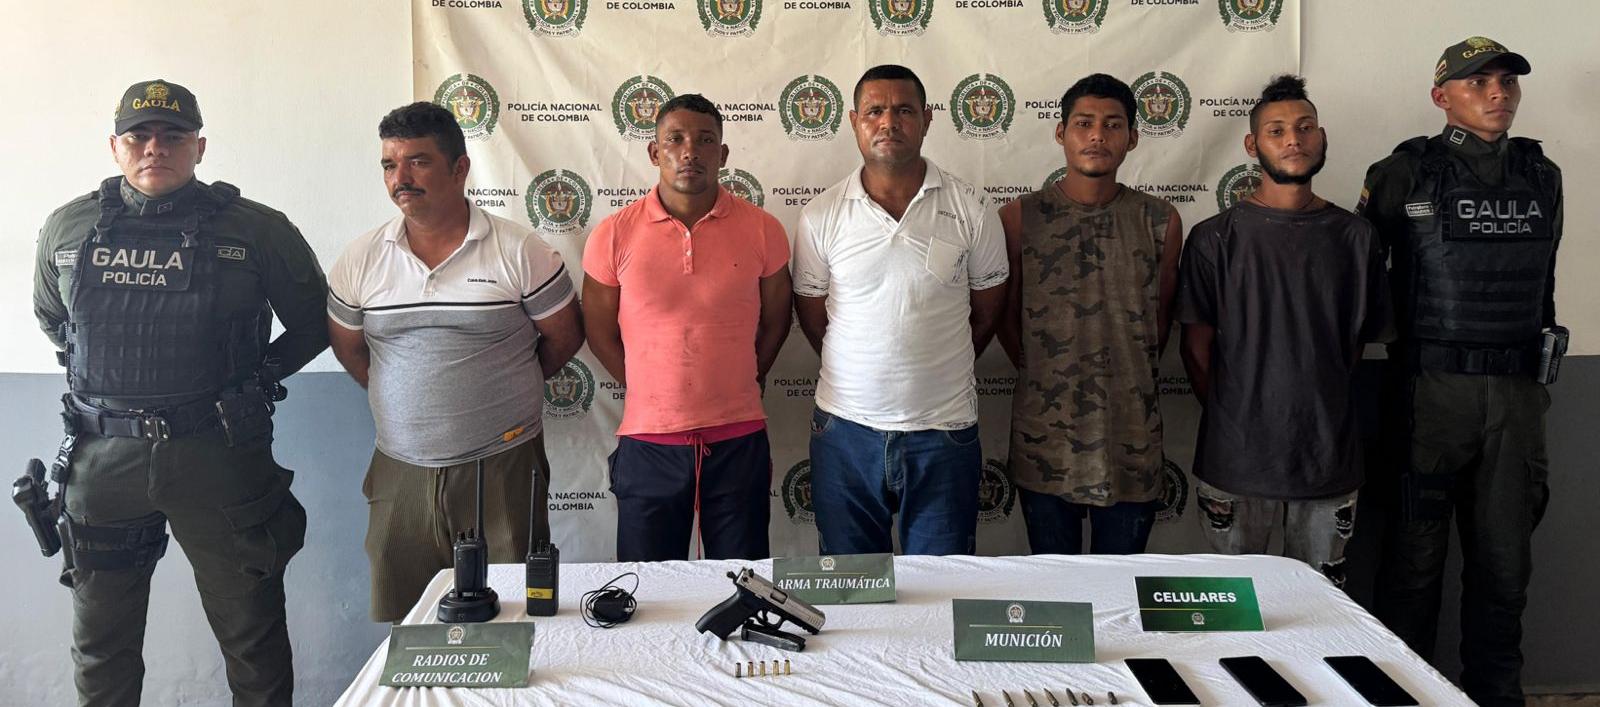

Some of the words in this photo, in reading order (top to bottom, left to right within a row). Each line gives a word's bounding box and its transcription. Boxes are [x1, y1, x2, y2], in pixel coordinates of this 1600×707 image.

[449, 0, 502, 8] COLOMBIA
[606, 2, 620, 10] DE
[622, 2, 675, 10] COLOMBIA
[784, 1, 797, 9] DE
[800, 1, 851, 9] COLOMBIA
[956, 0, 969, 8] DE
[971, 0, 1023, 8] COLOMBIA
[132, 98, 181, 112] GAULA
[1026, 99, 1062, 109] POLICÍA
[1200, 97, 1239, 106] POLICÍA
[508, 102, 547, 111] POLICÍA
[550, 103, 602, 111] NACIONAL
[725, 103, 776, 111] NACIONAL
[1214, 109, 1226, 117] DE
[522, 114, 534, 122] DE
[537, 114, 590, 122] COLOMBIA
[722, 114, 763, 122] OLOMBIA
[598, 187, 636, 196] POLICÍA
[773, 187, 810, 195] POLICÍA
[1129, 183, 1155, 192] LICÍA
[1157, 184, 1208, 192] NACIONAL
[467, 189, 519, 197] NACIONAL
[475, 199, 506, 207] OMBIA
[611, 199, 623, 207] DE
[1164, 194, 1195, 203] OMBIA
[1457, 200, 1543, 219] GAULA
[1469, 219, 1532, 234] POLICÍA
[92, 248, 184, 270] GAULA
[102, 269, 167, 287] POLICÍA
[774, 377, 812, 386] POLICÍA
[787, 389, 799, 397] DE
[555, 492, 607, 500] NACIONAL
[549, 503, 594, 511] OLOMBIA
[778, 578, 811, 590] ARMA
[814, 576, 890, 590] TRAUMÁTICA
[1153, 592, 1237, 603] CELULARES
[984, 630, 1063, 647] MUNICIÓN
[412, 654, 467, 667] RADIOS
[468, 653, 490, 666] DE
[391, 672, 503, 684] COMUNICACION
